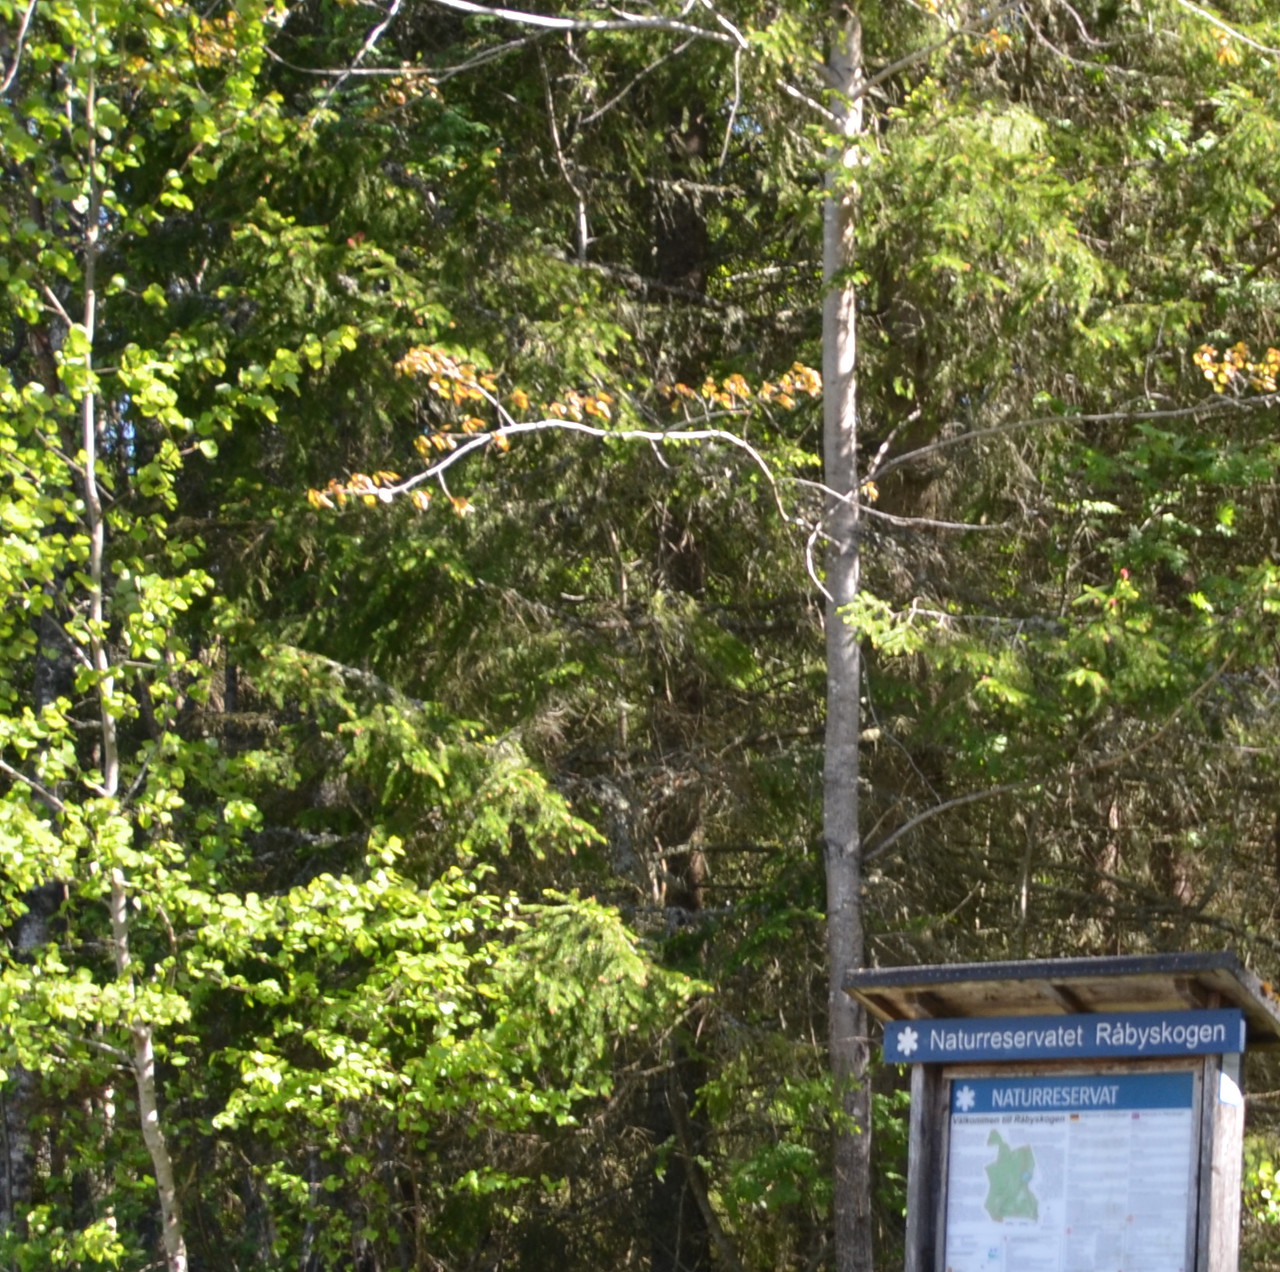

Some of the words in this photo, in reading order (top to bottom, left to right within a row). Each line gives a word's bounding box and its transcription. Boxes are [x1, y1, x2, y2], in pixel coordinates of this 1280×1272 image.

[930, 1025, 1083, 1050] Naturreservatet
[1096, 1021, 1226, 1049] Råbyskogen
[992, 1085, 1119, 1107] NATURRESERVAT
